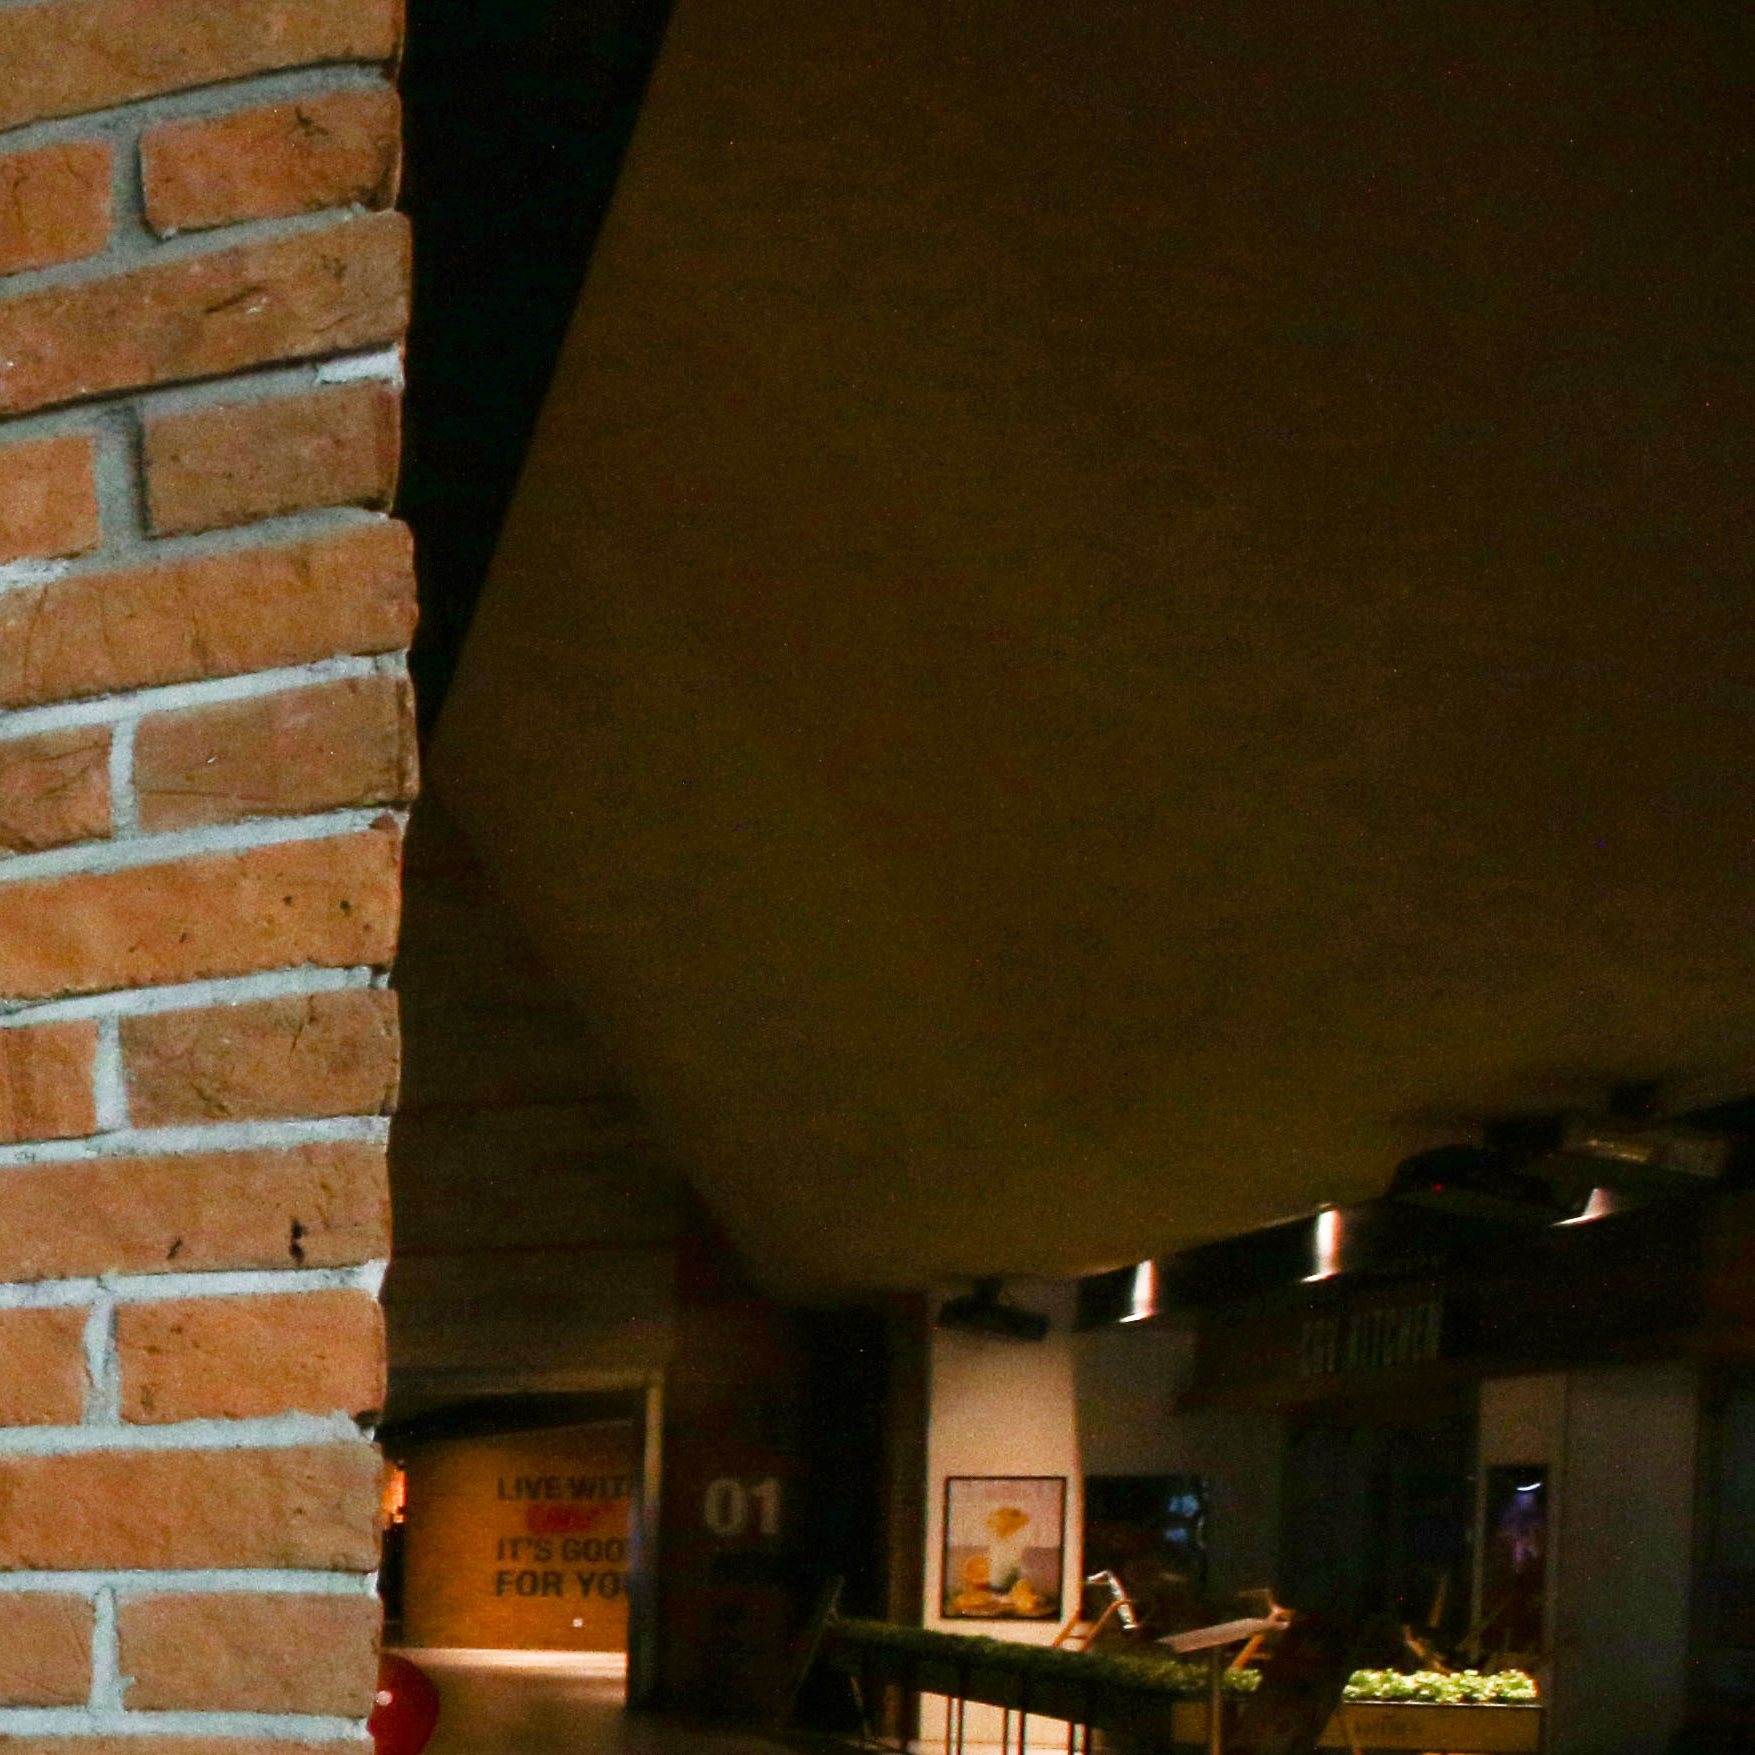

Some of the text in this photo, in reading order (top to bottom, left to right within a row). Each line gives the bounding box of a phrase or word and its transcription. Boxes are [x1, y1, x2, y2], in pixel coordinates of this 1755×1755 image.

[497, 1474, 632, 1501] LIVE WIT
[704, 1478, 783, 1536] 01
[496, 1537, 626, 1562] IT'S GOO
[496, 1570, 629, 1599] FOR YO
